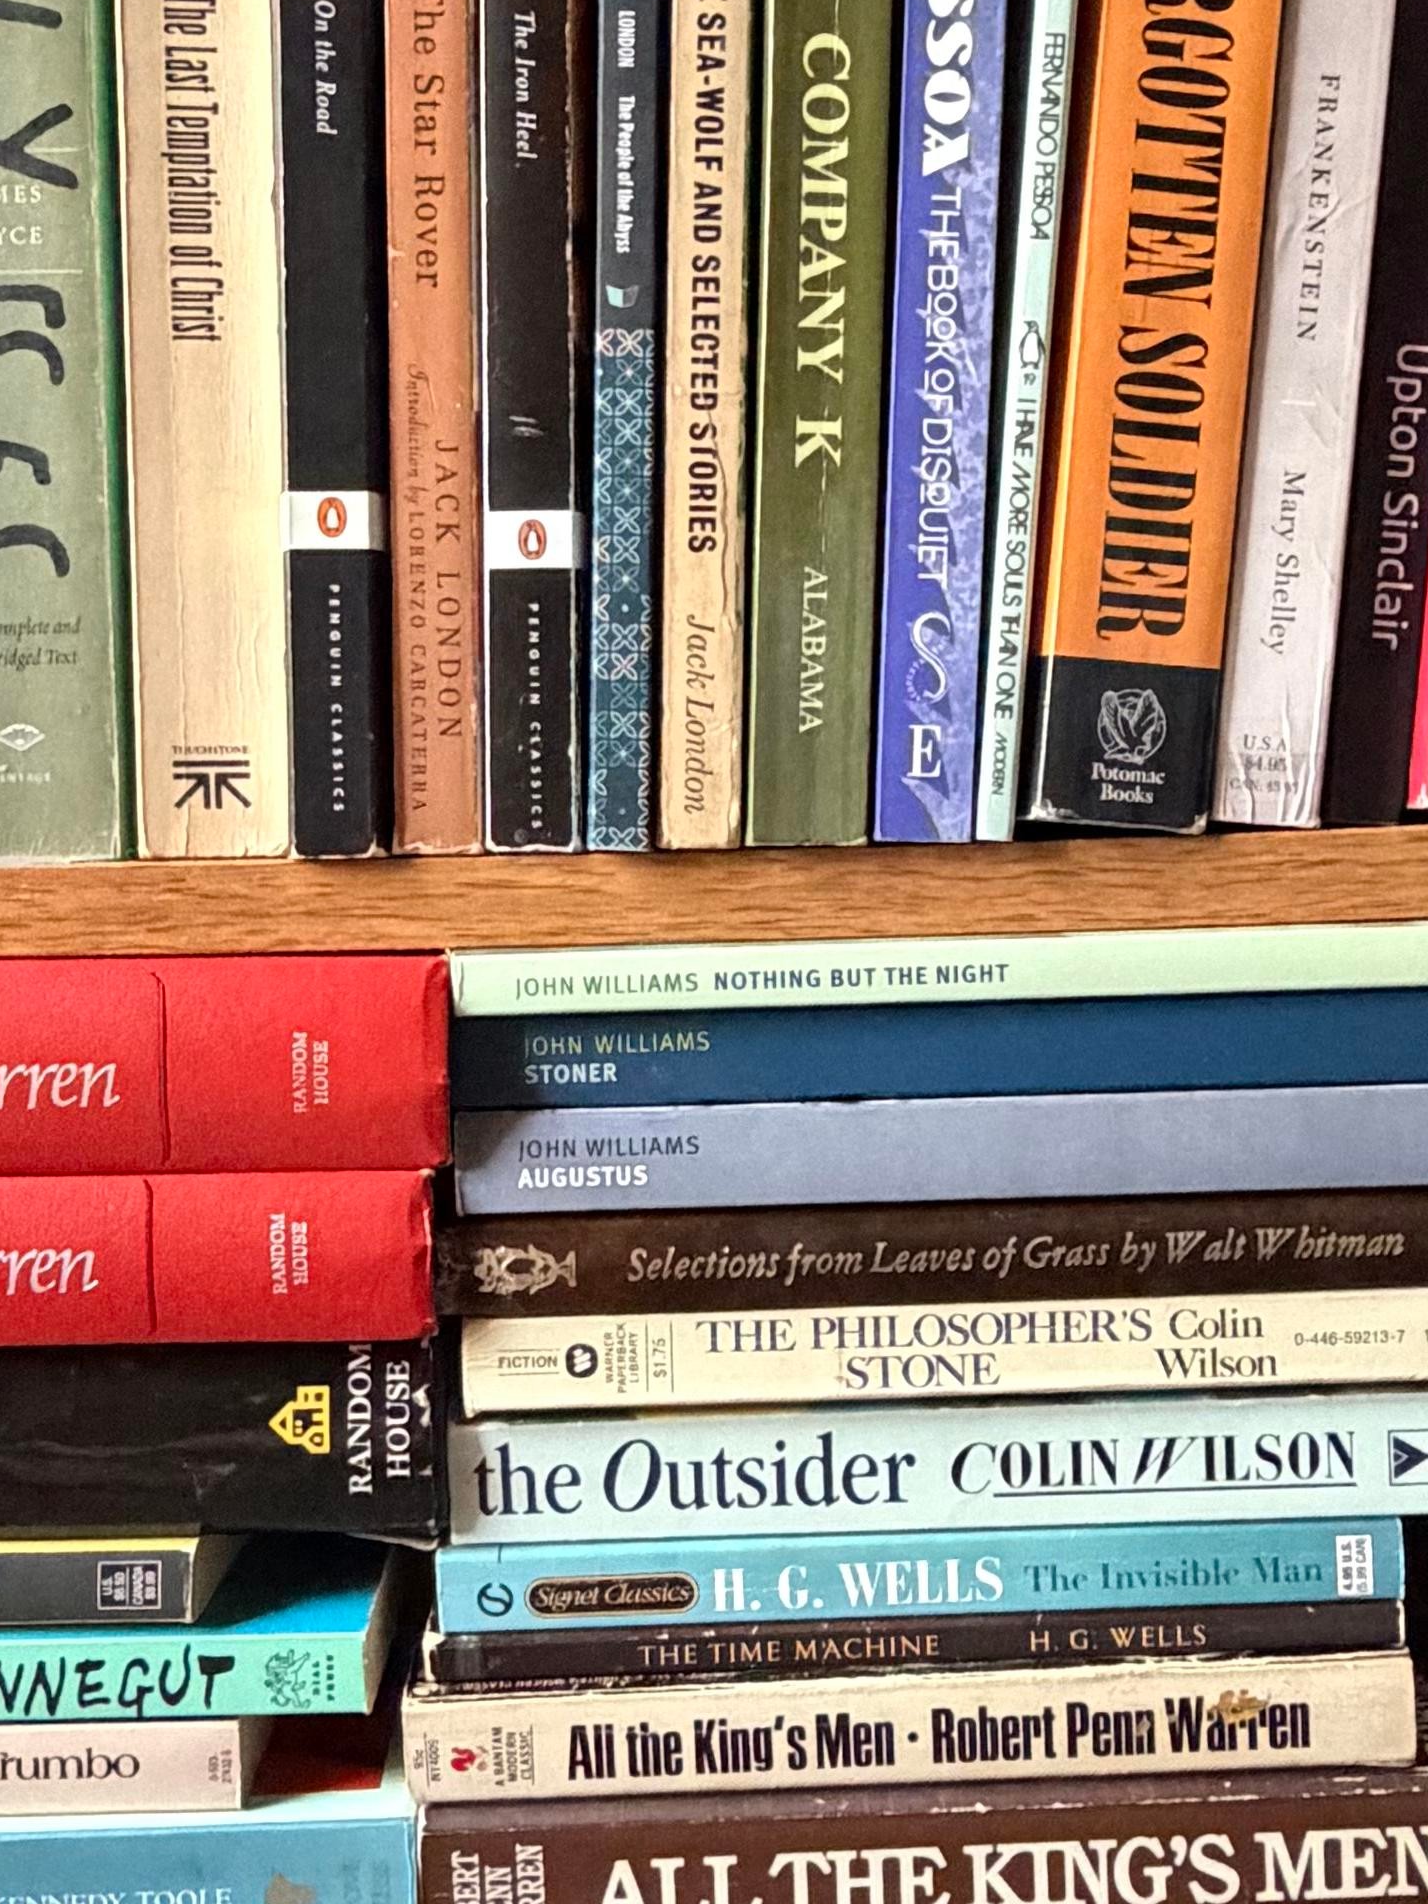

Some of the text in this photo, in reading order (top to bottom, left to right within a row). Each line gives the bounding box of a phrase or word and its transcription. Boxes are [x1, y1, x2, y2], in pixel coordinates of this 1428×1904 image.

[313, 0, 336, 135] On the Road
[413, 67, 444, 155] Star
[694, 13, 729, 169] SEA-WOLF
[415, 175, 446, 291] Rover
[692, 177, 723, 242] AND
[794, 31, 852, 468] COMPANY K
[1295, 73, 1341, 342] FRANKENSTEIN
[690, 255, 721, 411] SELECTED
[688, 423, 718, 554] STORIES
[1095, 325, 1209, 641] SOLDIER
[1266, 471, 1306, 656] Mary Shelley
[1370, 490, 1423, 650] Sinclair
[685, 614, 715, 814] Jack London
[799, 567, 827, 735] ALABAMA
[1091, 763, 1165, 804] Potomac Books
[515, 961, 1010, 1001] JOHN WILLIAMS NOTHING BUT THE NIGHT
[524, 1061, 618, 1085] STONER
[518, 1162, 649, 1190] AUGUSTUS
[474, 1435, 918, 1516] the Outsider
[949, 1429, 1357, 1489] COLIN WILSON
[712, 1556, 1006, 1611] H. G. WELLS
